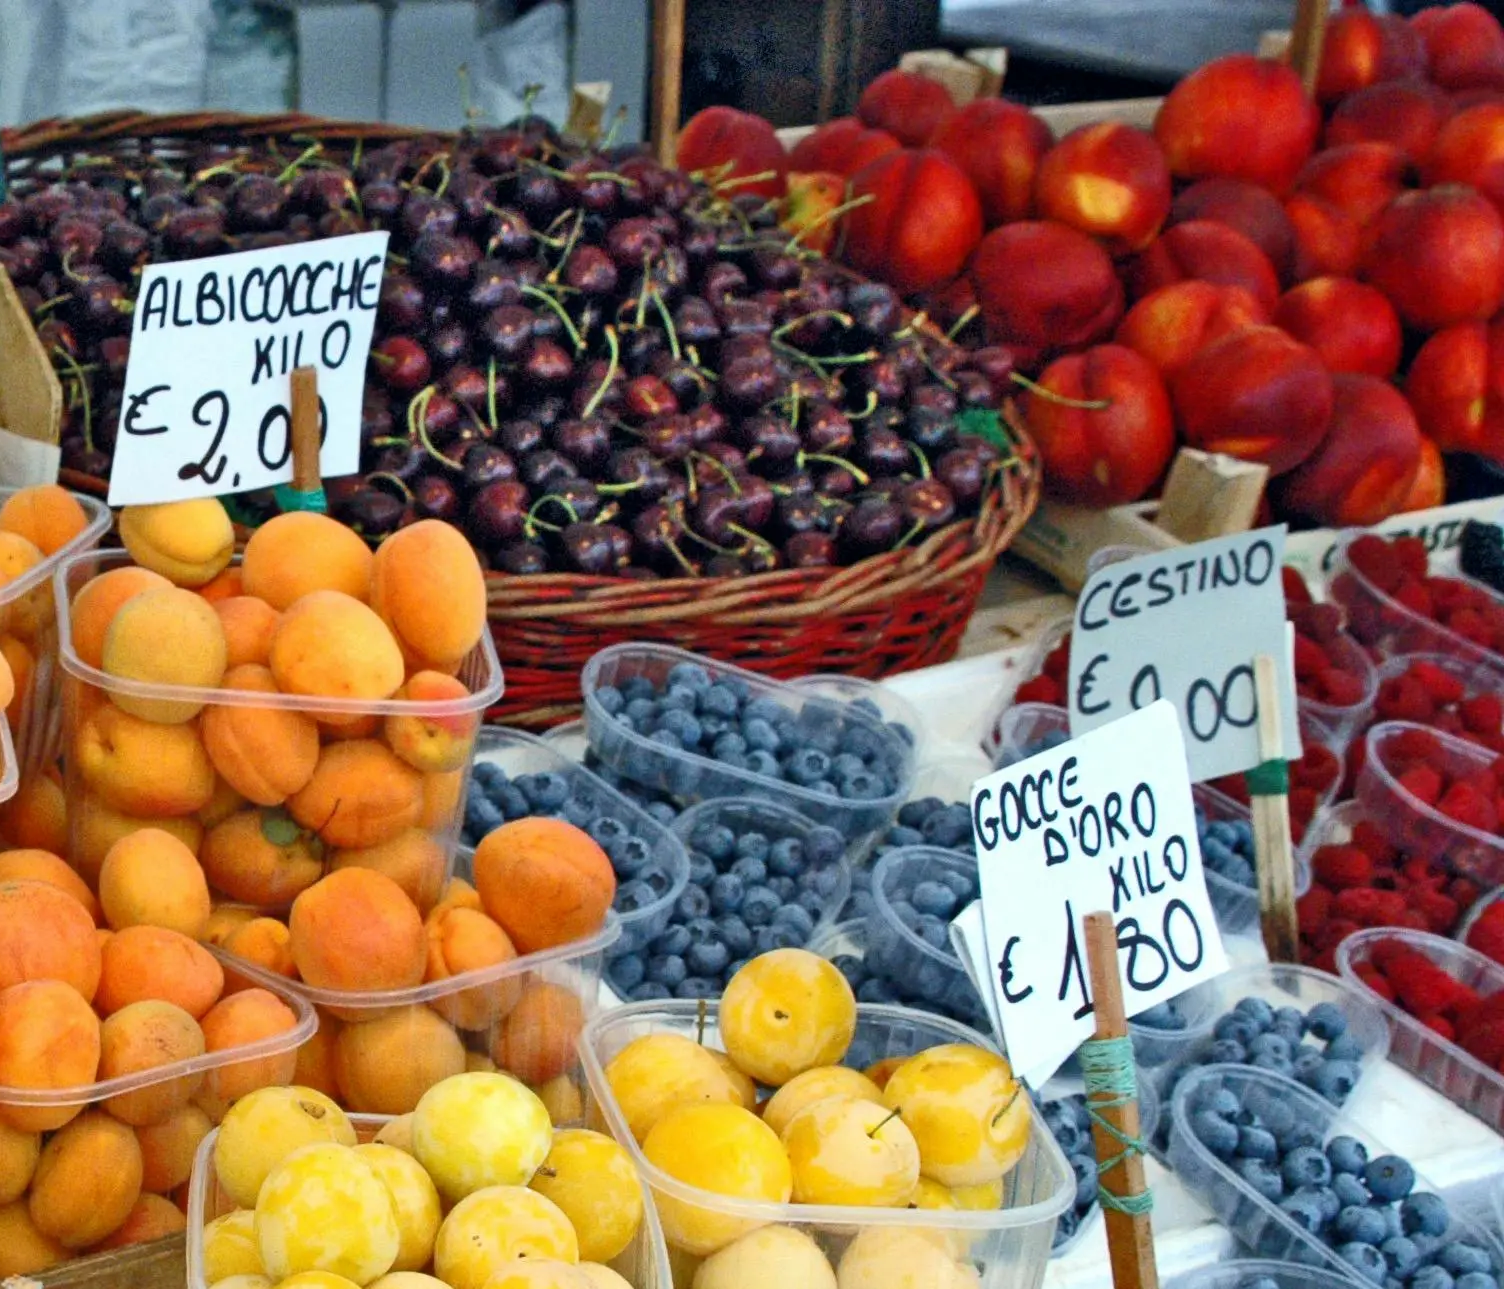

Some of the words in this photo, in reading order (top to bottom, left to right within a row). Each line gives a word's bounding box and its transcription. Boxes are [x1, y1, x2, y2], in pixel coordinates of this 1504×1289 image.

[141, 255, 382, 332] ALBICOCCHE
[251, 319, 351, 385] KILO
[124, 384, 172, 436] €
[1079, 539, 1275, 631] CESTINO
[974, 756, 1083, 852] GOCCE
[1043, 782, 1156, 867] D'ORO
[1108, 835, 1189, 913] KILO
